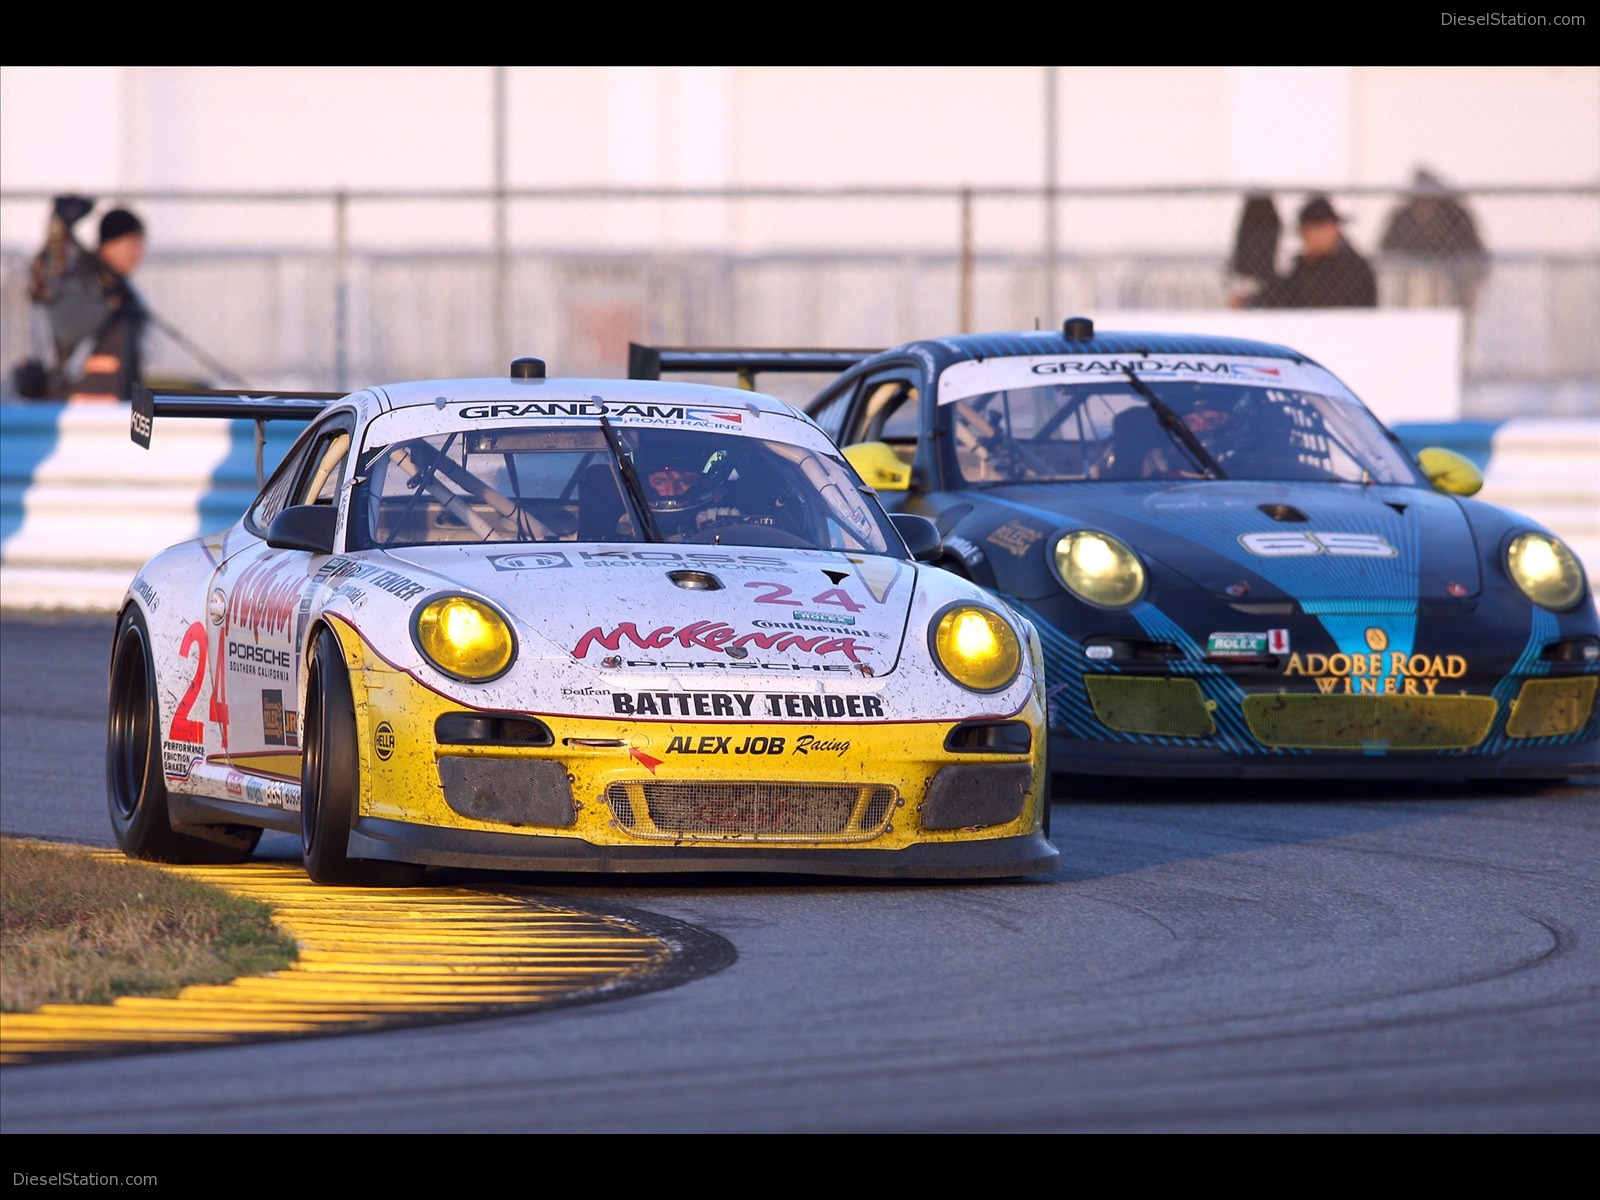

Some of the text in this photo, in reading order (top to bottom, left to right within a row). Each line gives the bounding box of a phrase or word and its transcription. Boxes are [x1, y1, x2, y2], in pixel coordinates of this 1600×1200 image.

[1031, 359, 1230, 376] GRAND-AM
[458, 403, 684, 419] GRAND-AM
[629, 417, 742, 431] ROAD RACING
[1237, 532, 1399, 558] 65
[578, 551, 787, 567] KOSS
[584, 560, 798, 573] stereophones
[744, 581, 867, 613] 24
[752, 620, 871, 637] Continental
[1214, 639, 1257, 649] ROLEX
[229, 642, 290, 668] PORSCHE
[230, 661, 289, 681] SOUTHERN CALIFORNIA
[627, 660, 851, 672] PORSCHE
[1283, 652, 1467, 678] ADOBE ROAD
[168, 621, 229, 748] 24
[1314, 676, 1438, 696] WINERY
[611, 693, 885, 718] BATTERY TENDER
[163, 741, 205, 755] PERFORMANCE
[665, 735, 851, 757] ALEX JOB Racing
[163, 751, 190, 763] FRICTION
[164, 763, 187, 773] BRAKES
